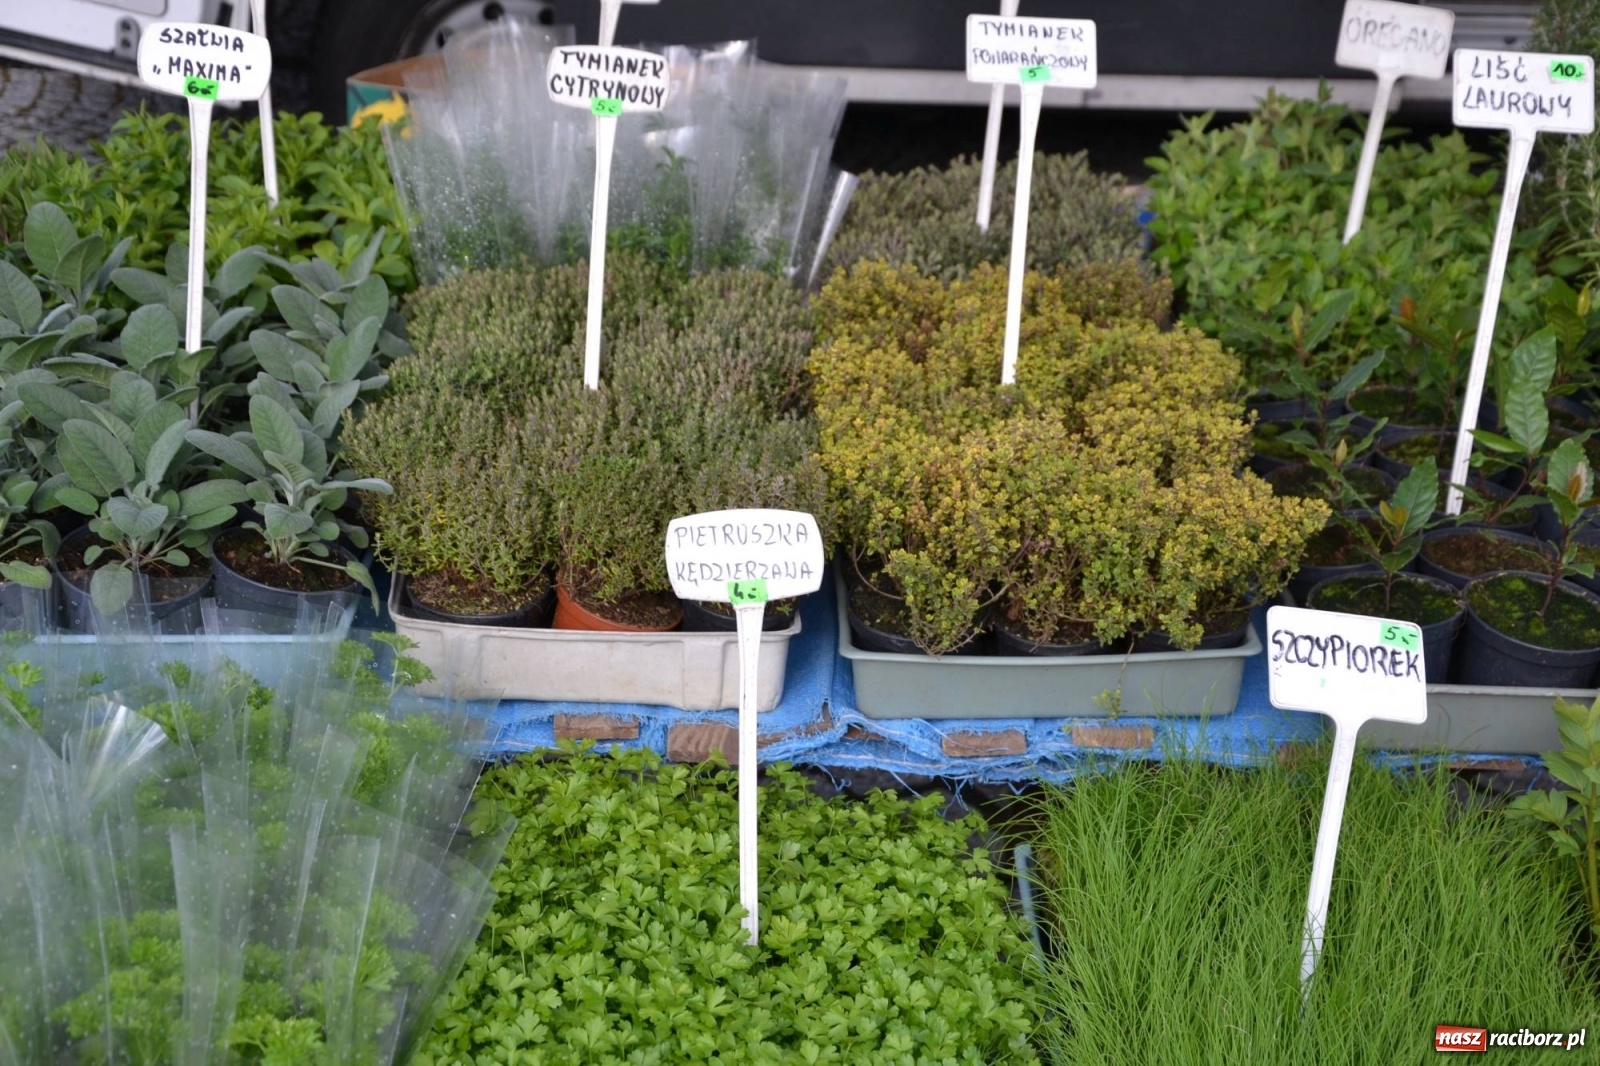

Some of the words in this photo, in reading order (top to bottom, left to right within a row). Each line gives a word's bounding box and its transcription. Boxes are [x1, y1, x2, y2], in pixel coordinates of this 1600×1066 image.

[159, 27, 244, 53] SZAŁWIA
[978, 20, 1084, 42] TYMIANEK
[560, 49, 664, 79] TYMIANEK
[1471, 55, 1527, 83] LIŚĆ
[550, 73, 665, 108] CYTRYNOWY
[1462, 85, 1572, 118] LAUROWY
[674, 522, 808, 549] PIETRUSZKA
[675, 560, 814, 587] KĘDZIERZAWA
[1272, 629, 1421, 683] SZCZYPIOREK
